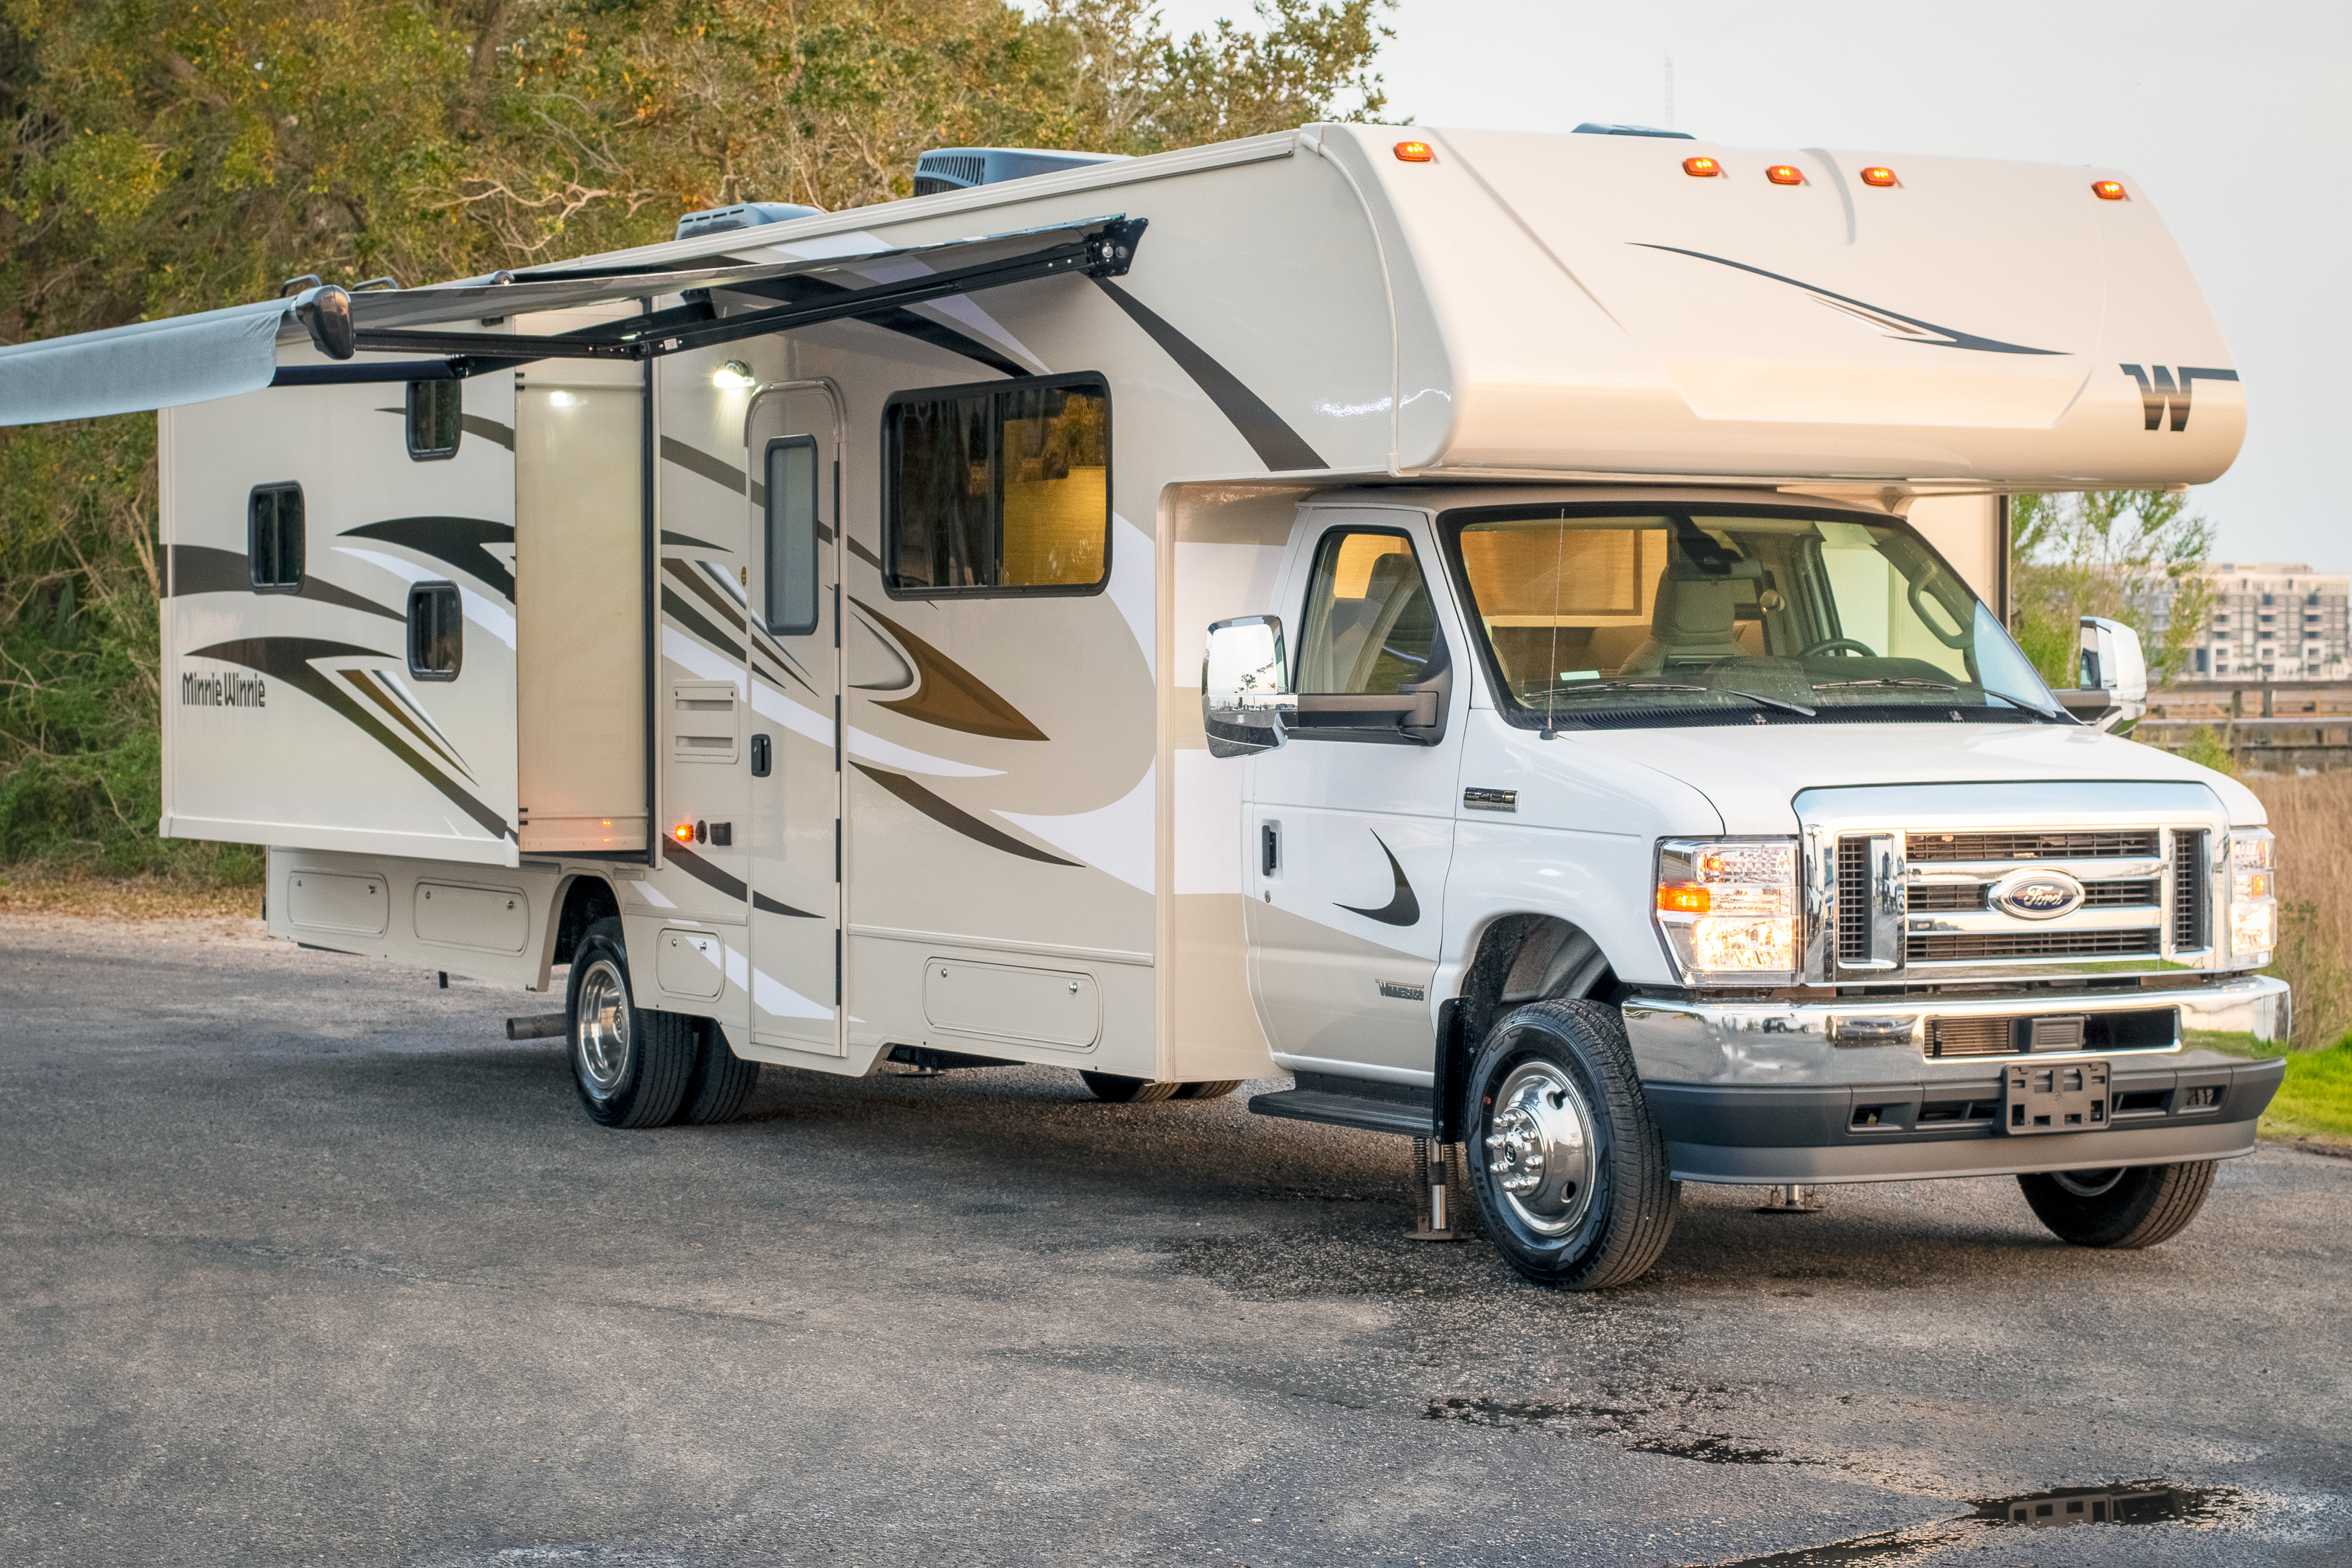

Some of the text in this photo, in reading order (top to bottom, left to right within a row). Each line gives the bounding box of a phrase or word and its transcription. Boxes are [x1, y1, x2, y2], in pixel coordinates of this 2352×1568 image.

[182, 672, 265, 708] Minnie Winnie
[2023, 885, 2064, 906] Ford
